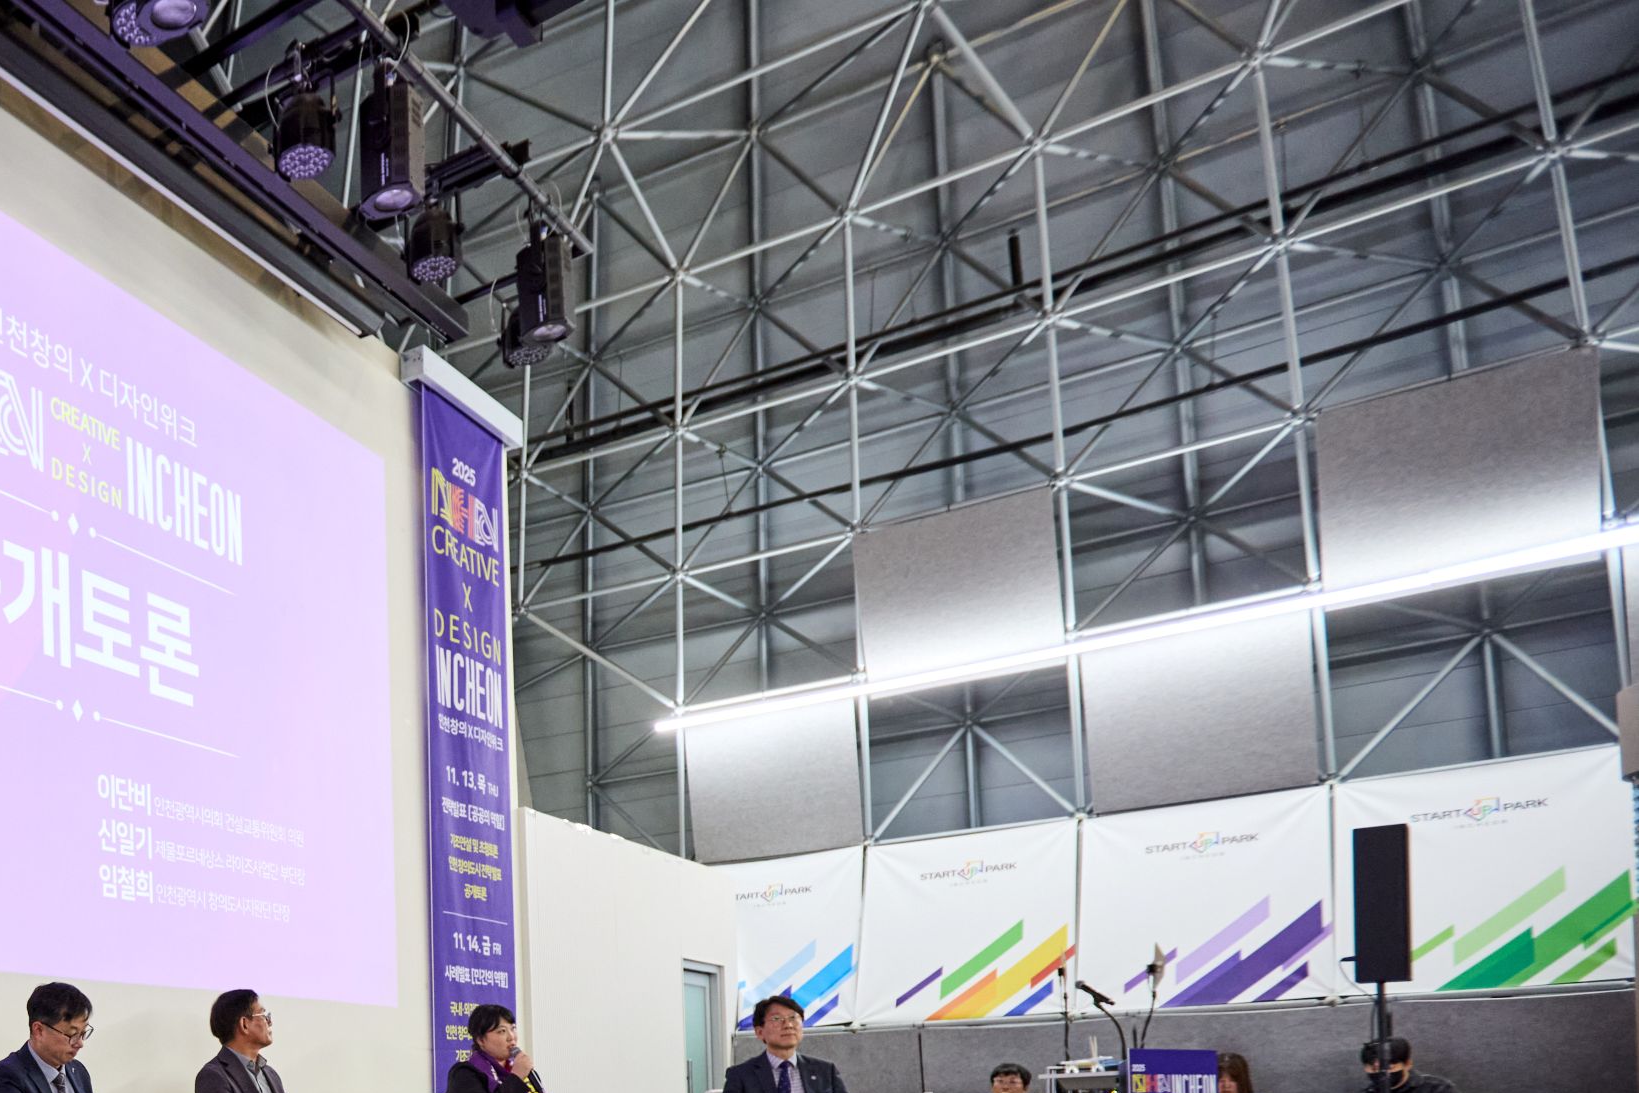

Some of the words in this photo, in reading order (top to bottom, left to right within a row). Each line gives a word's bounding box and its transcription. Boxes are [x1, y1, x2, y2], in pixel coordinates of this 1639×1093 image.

[49, 397, 122, 452] CREATIVE
[79, 361, 95, 394] X
[99, 369, 198, 449] 디자인위크
[81, 443, 93, 466] X
[451, 457, 477, 488] 2025
[50, 458, 124, 511] DESIGN
[126, 436, 244, 567] INCHEON
[431, 524, 500, 587] CREATIVE
[462, 582, 473, 613] X
[433, 607, 502, 667] DESIGN
[435, 644, 504, 729] INCHEON
[97, 773, 152, 817] 이단비
[445, 765, 460, 787] 11.
[461, 769, 477, 791] 13.
[1410, 808, 1463, 823] START
[1502, 798, 1549, 812] PARK
[97, 818, 153, 861] 신일기
[1145, 842, 1187, 855] START
[1221, 832, 1260, 844] PARK
[98, 863, 154, 905] 임철희
[784, 885, 813, 896] PARK
[920, 869, 957, 881] START
[984, 862, 1018, 873] PARK
[452, 931, 466, 952] 11.
